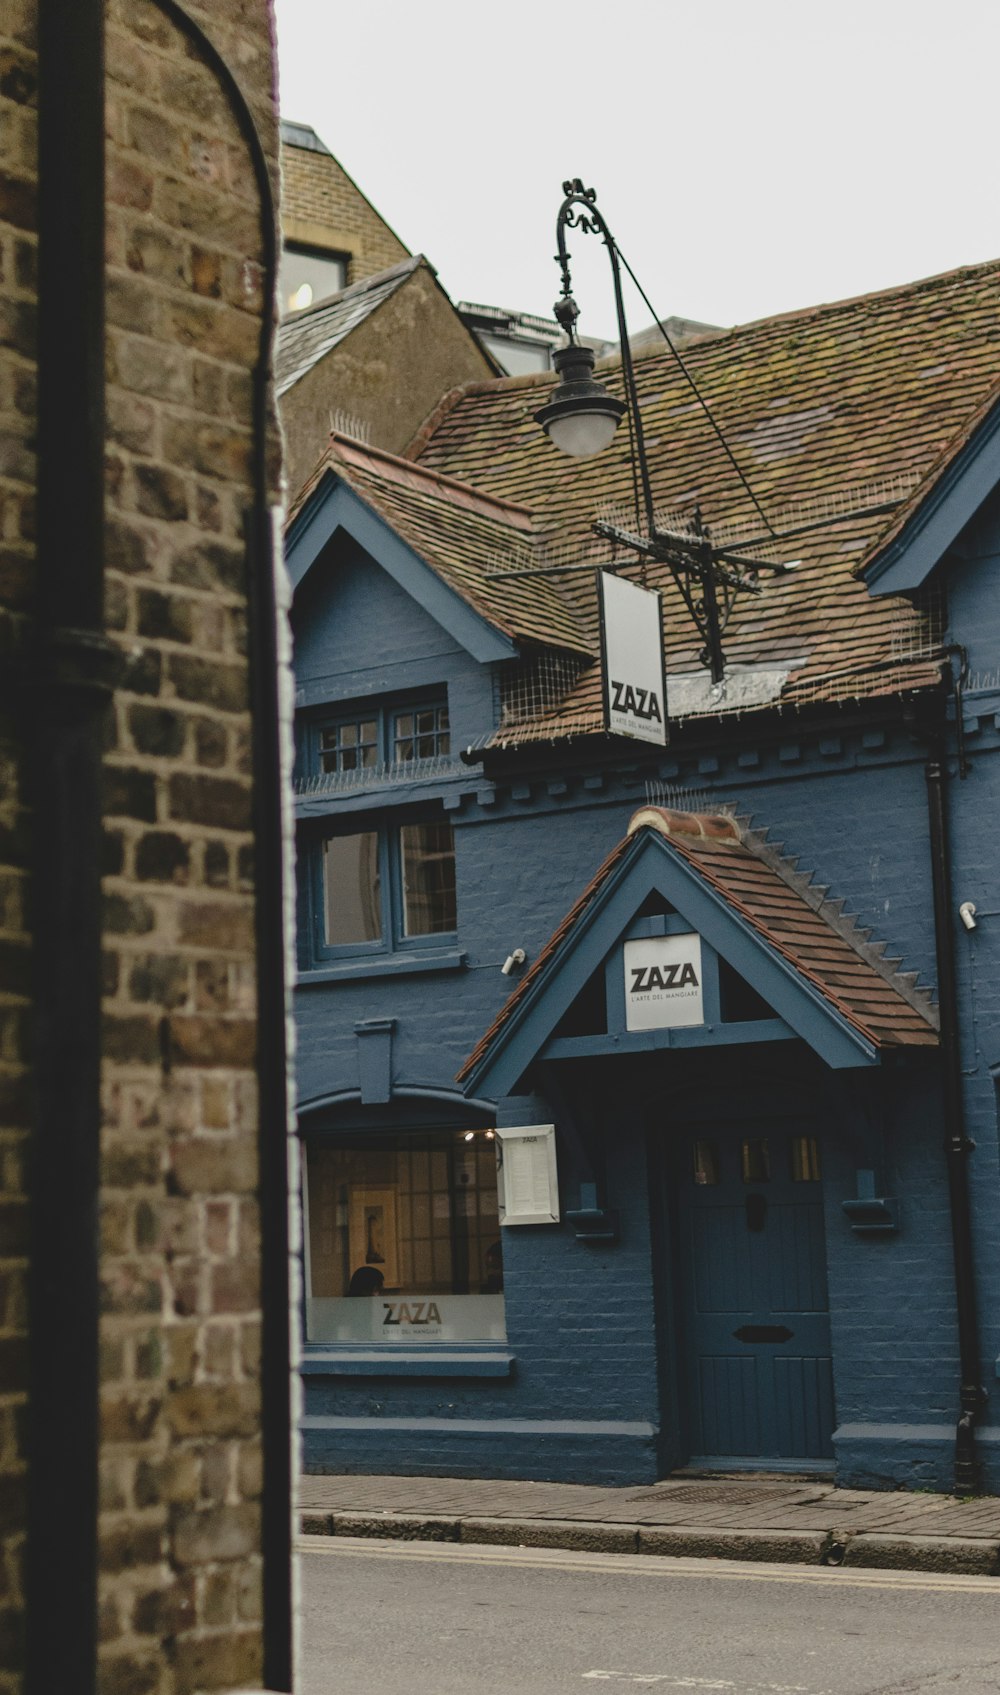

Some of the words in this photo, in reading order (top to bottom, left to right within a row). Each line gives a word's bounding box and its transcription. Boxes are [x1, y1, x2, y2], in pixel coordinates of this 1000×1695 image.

[611, 680, 662, 723] ZAZA
[628, 719, 637, 729] DEL
[630, 962, 699, 993] ZAZA
[631, 995, 651, 1003] L'ARTE
[665, 990, 698, 999] MANGIARE
[383, 1302, 442, 1325] ZAZA
